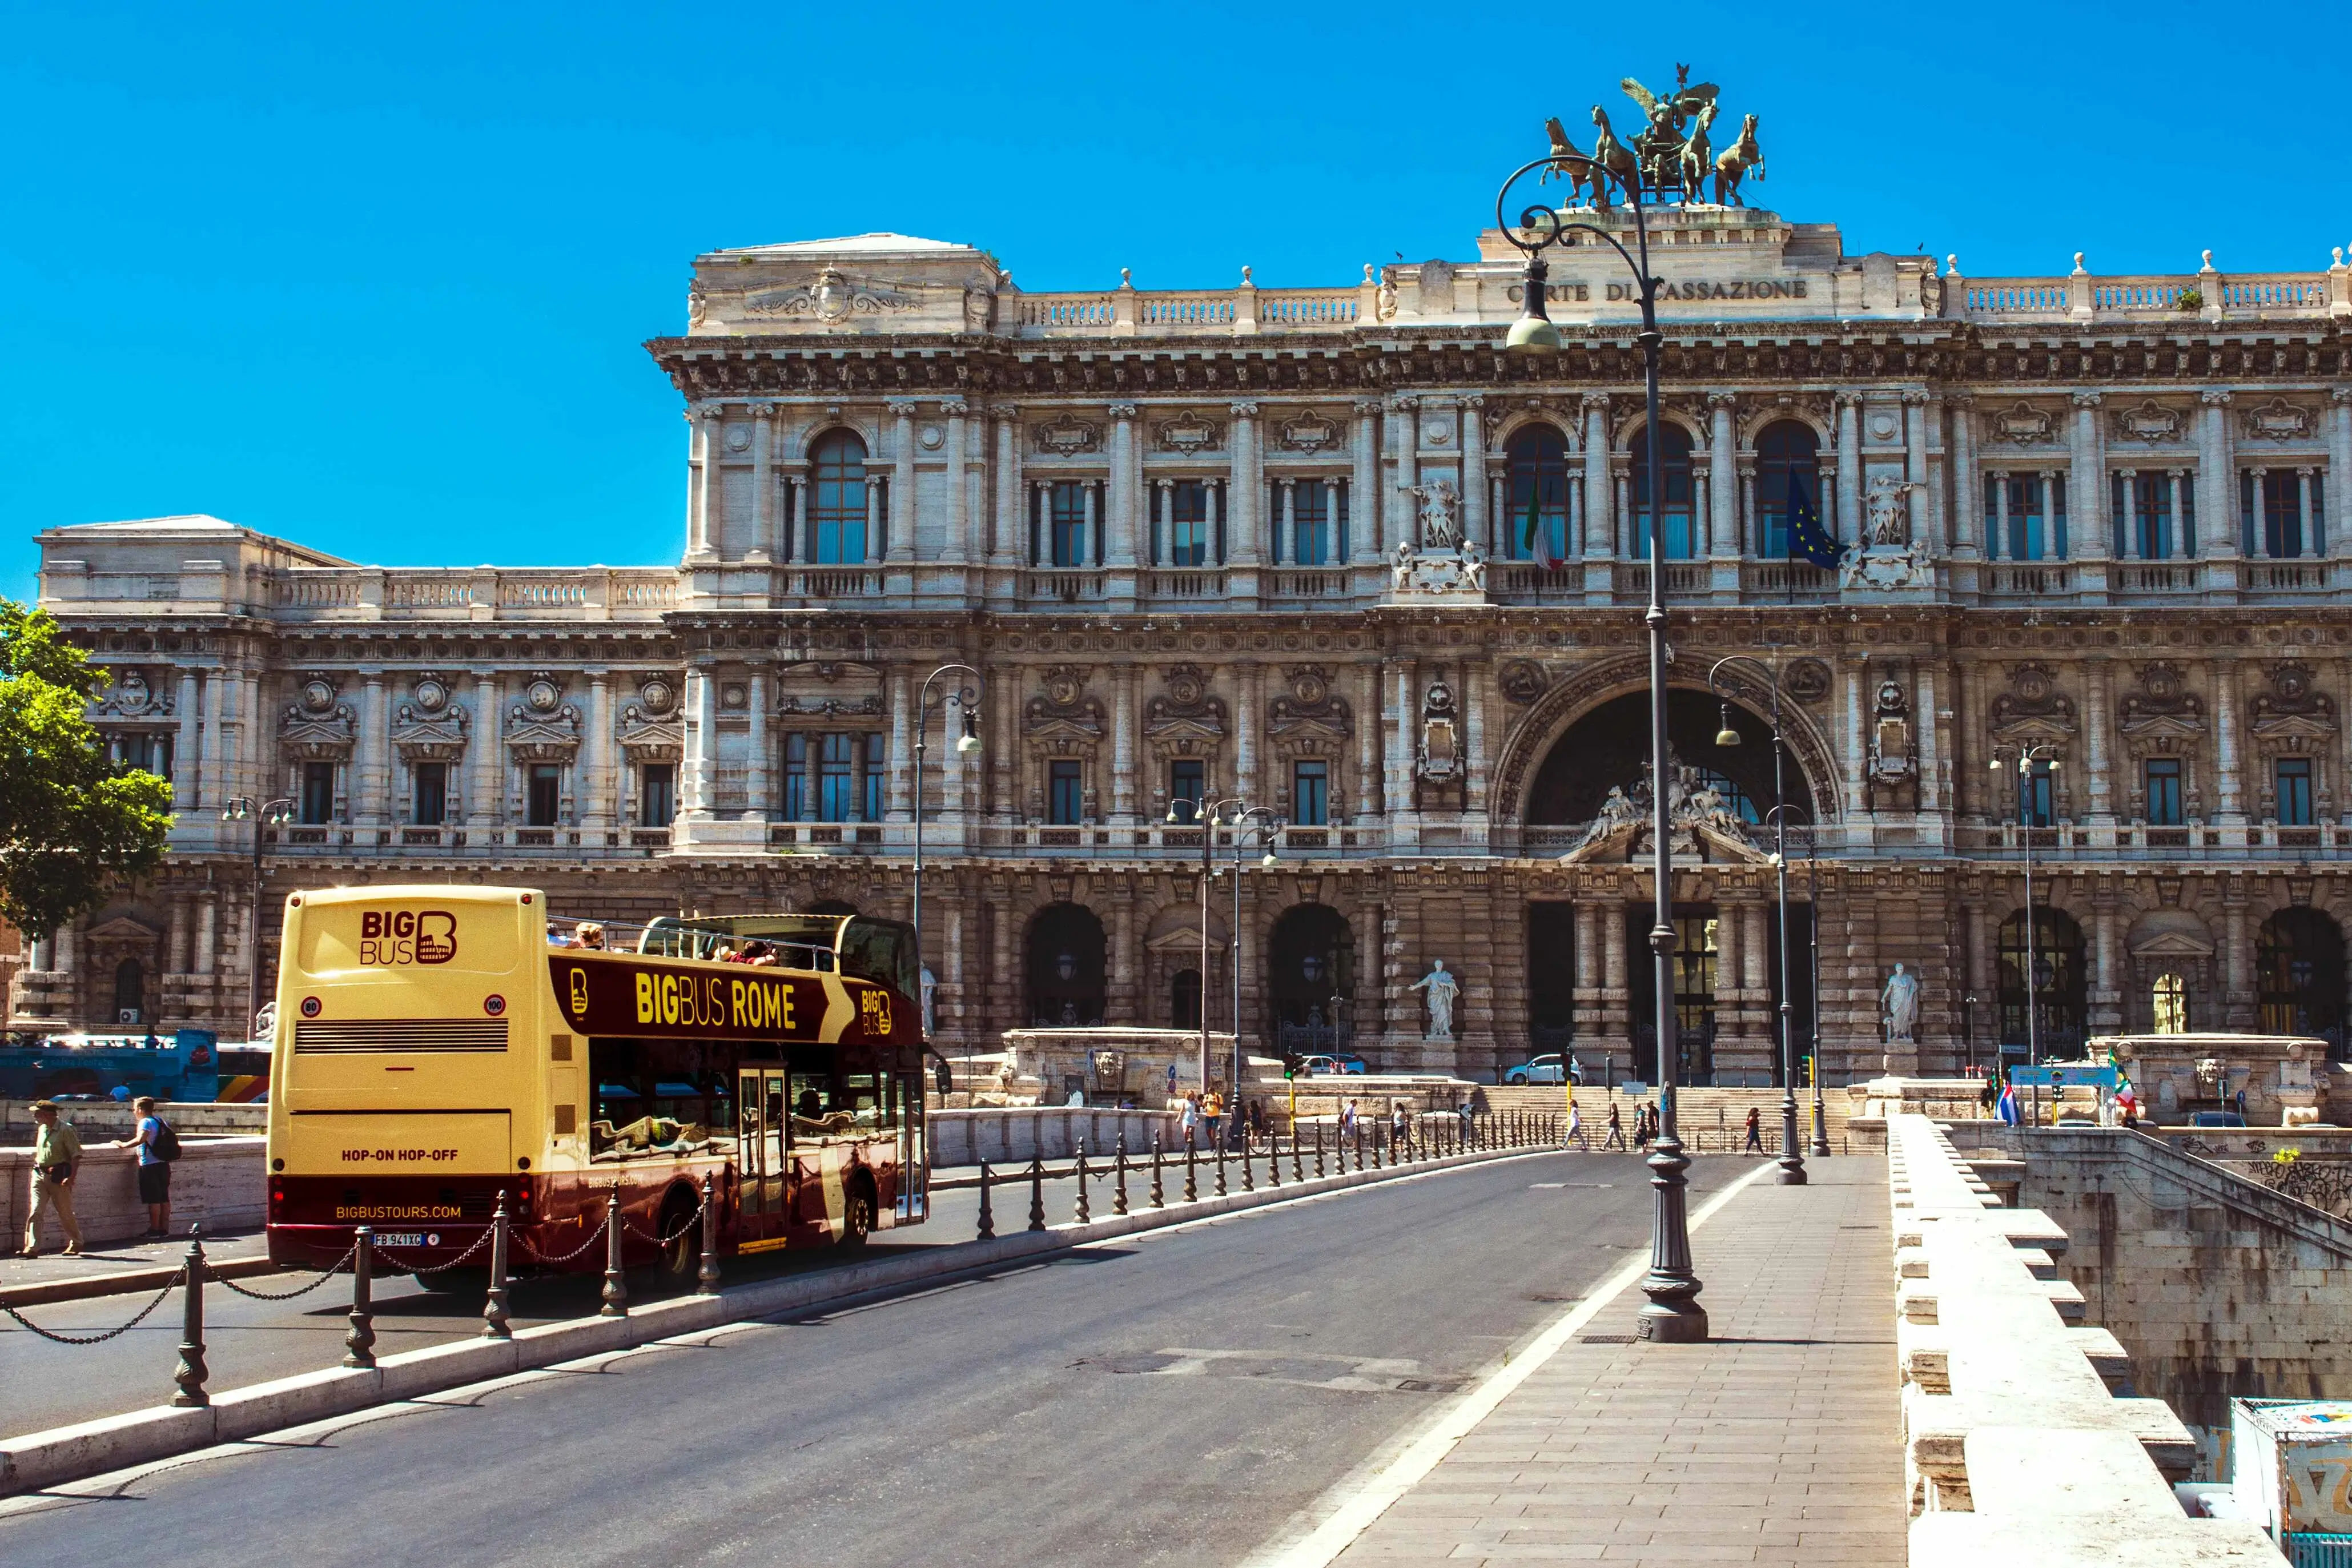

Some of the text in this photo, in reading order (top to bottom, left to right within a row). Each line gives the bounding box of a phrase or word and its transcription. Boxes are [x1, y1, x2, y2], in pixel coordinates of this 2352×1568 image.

[1507, 284, 1589, 302] CRTE
[1606, 284, 1632, 301] DI
[361, 911, 415, 938] BIG
[360, 940, 413, 964] BUS
[305, 1002, 316, 1011] 80
[487, 1000, 502, 1010] 100
[732, 980, 796, 1029] ROME
[862, 990, 878, 1013] BIG
[863, 1015, 880, 1035] BUS
[342, 1149, 459, 1161] HOP-ON HOP-OFF
[589, 1174, 644, 1189] BIGBUSTURS.COM
[336, 1206, 461, 1218] BIGBUSTOURS.COM
[376, 1235, 388, 1245] FB
